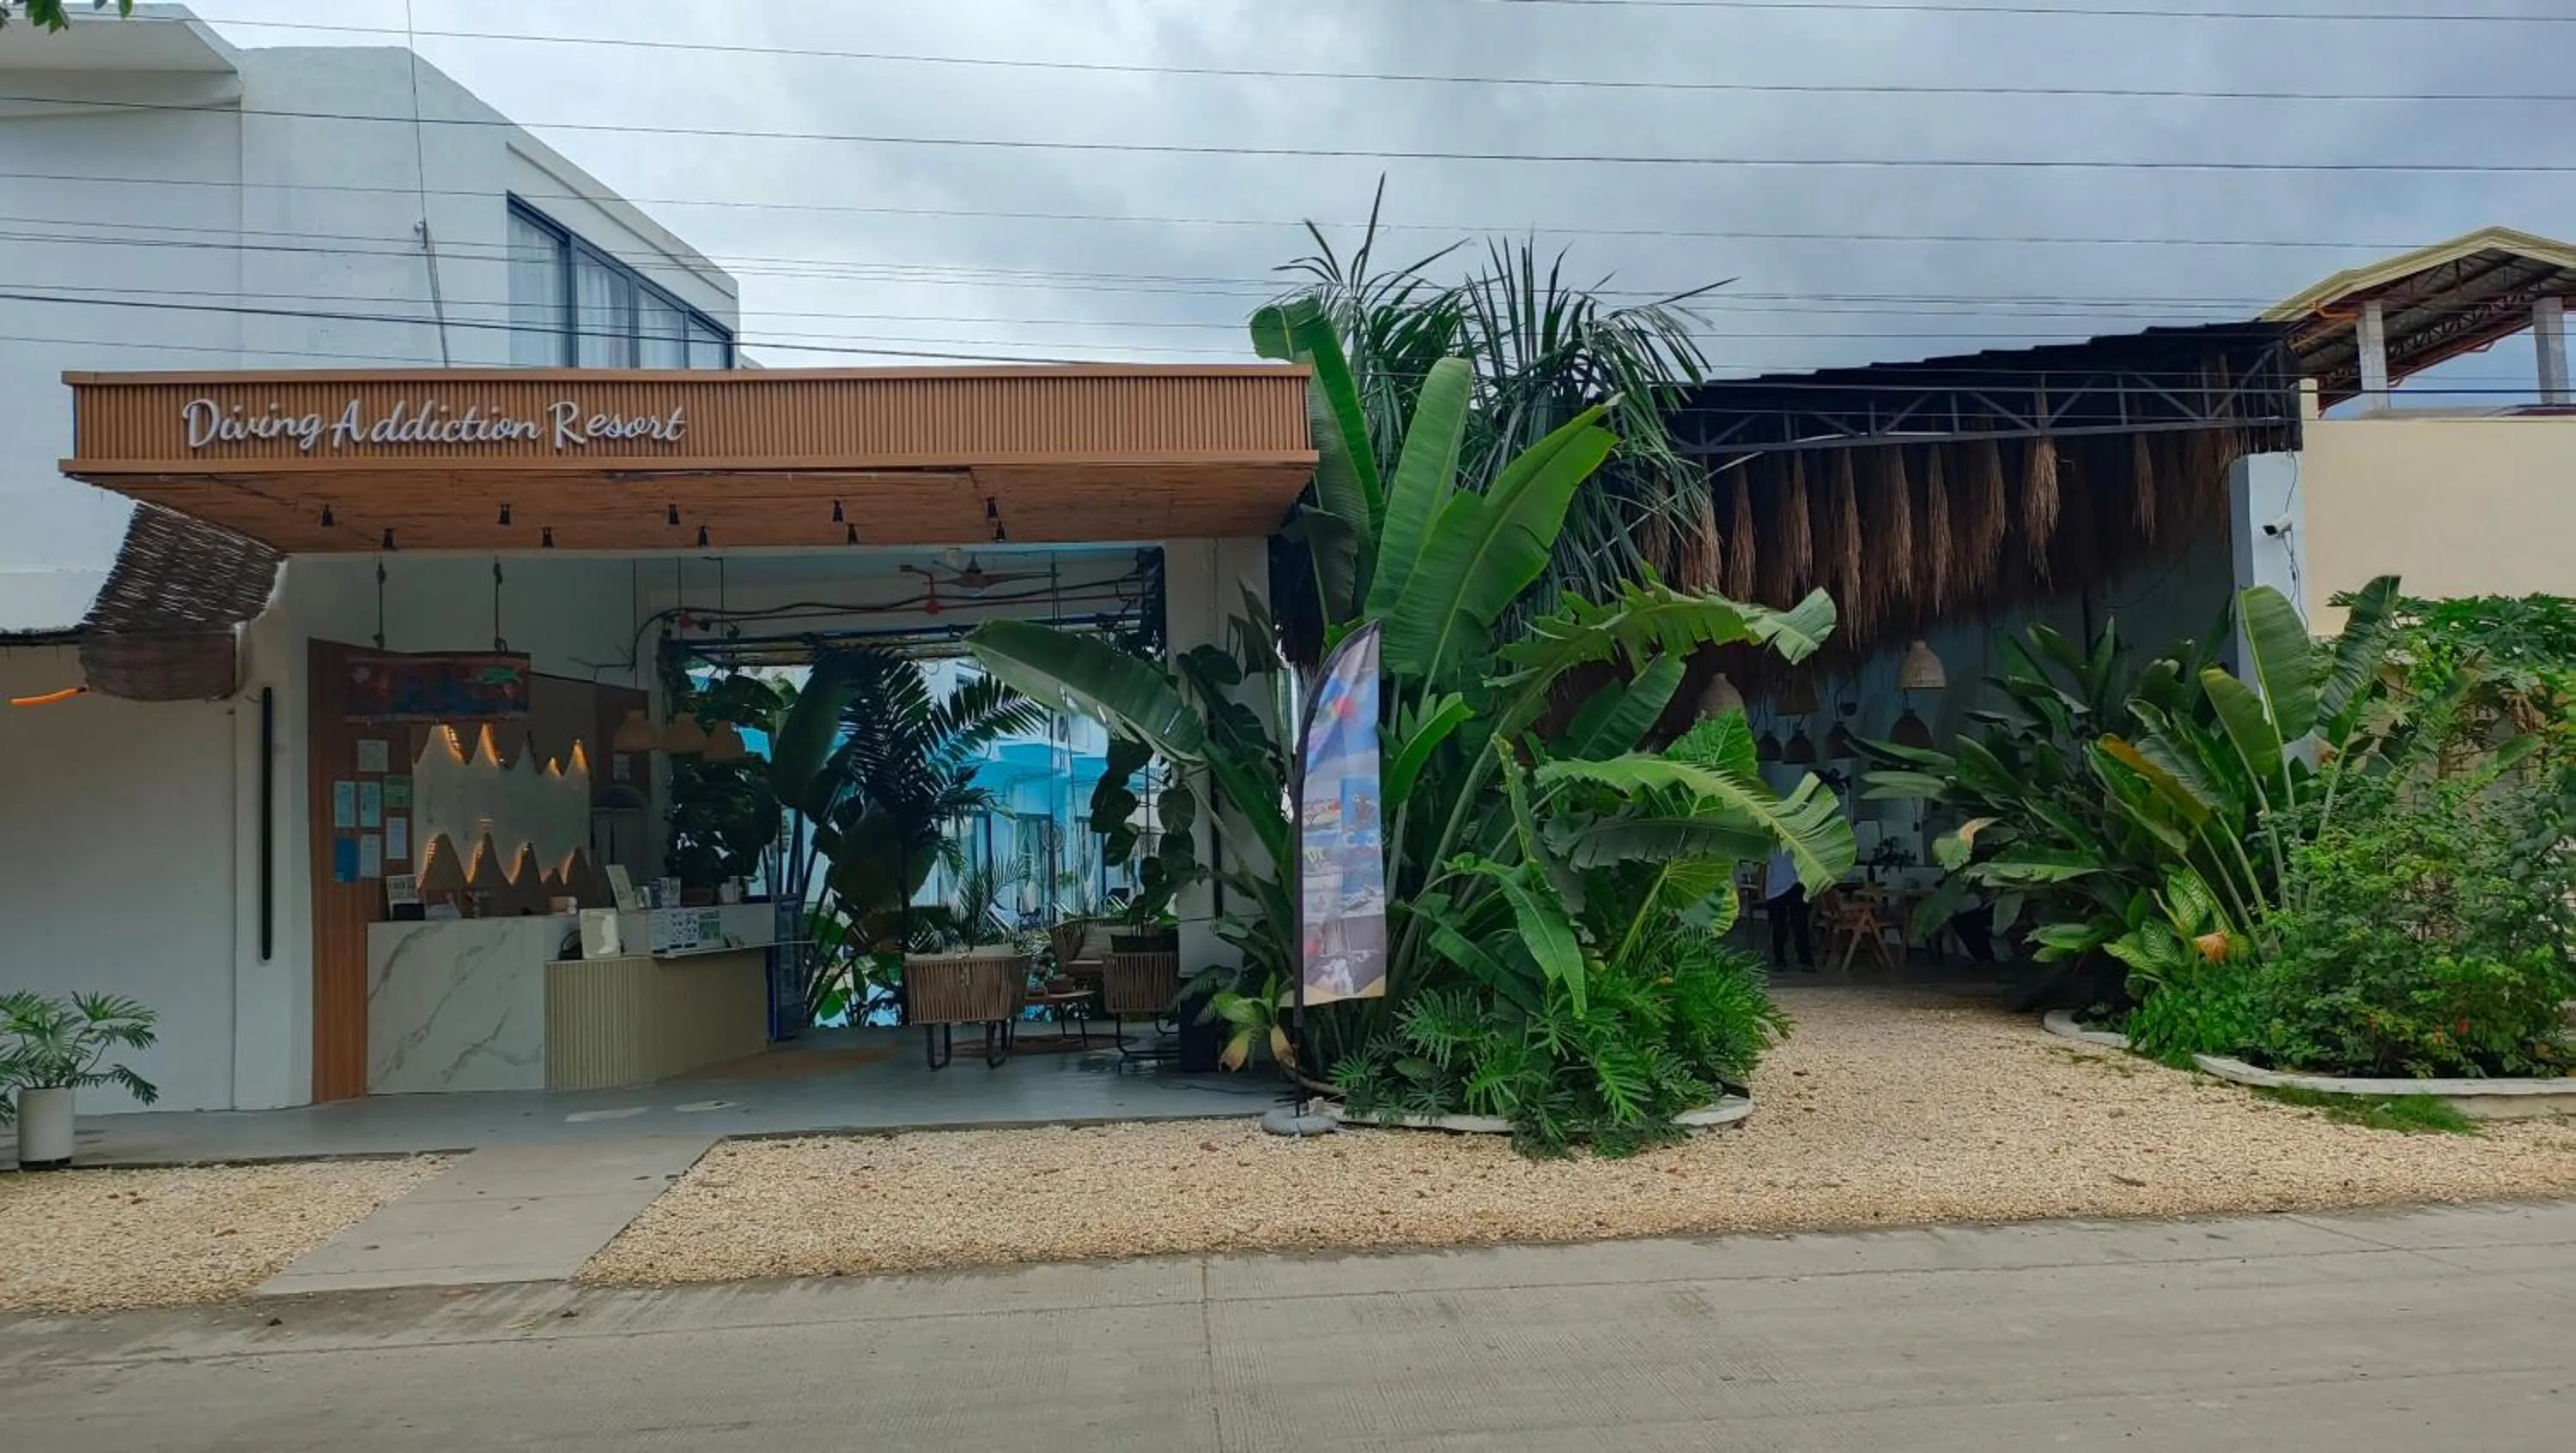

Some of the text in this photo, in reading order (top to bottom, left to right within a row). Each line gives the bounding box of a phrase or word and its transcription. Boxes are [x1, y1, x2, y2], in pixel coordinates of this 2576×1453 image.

[181, 398, 688, 450] Diving Addiction Resort
